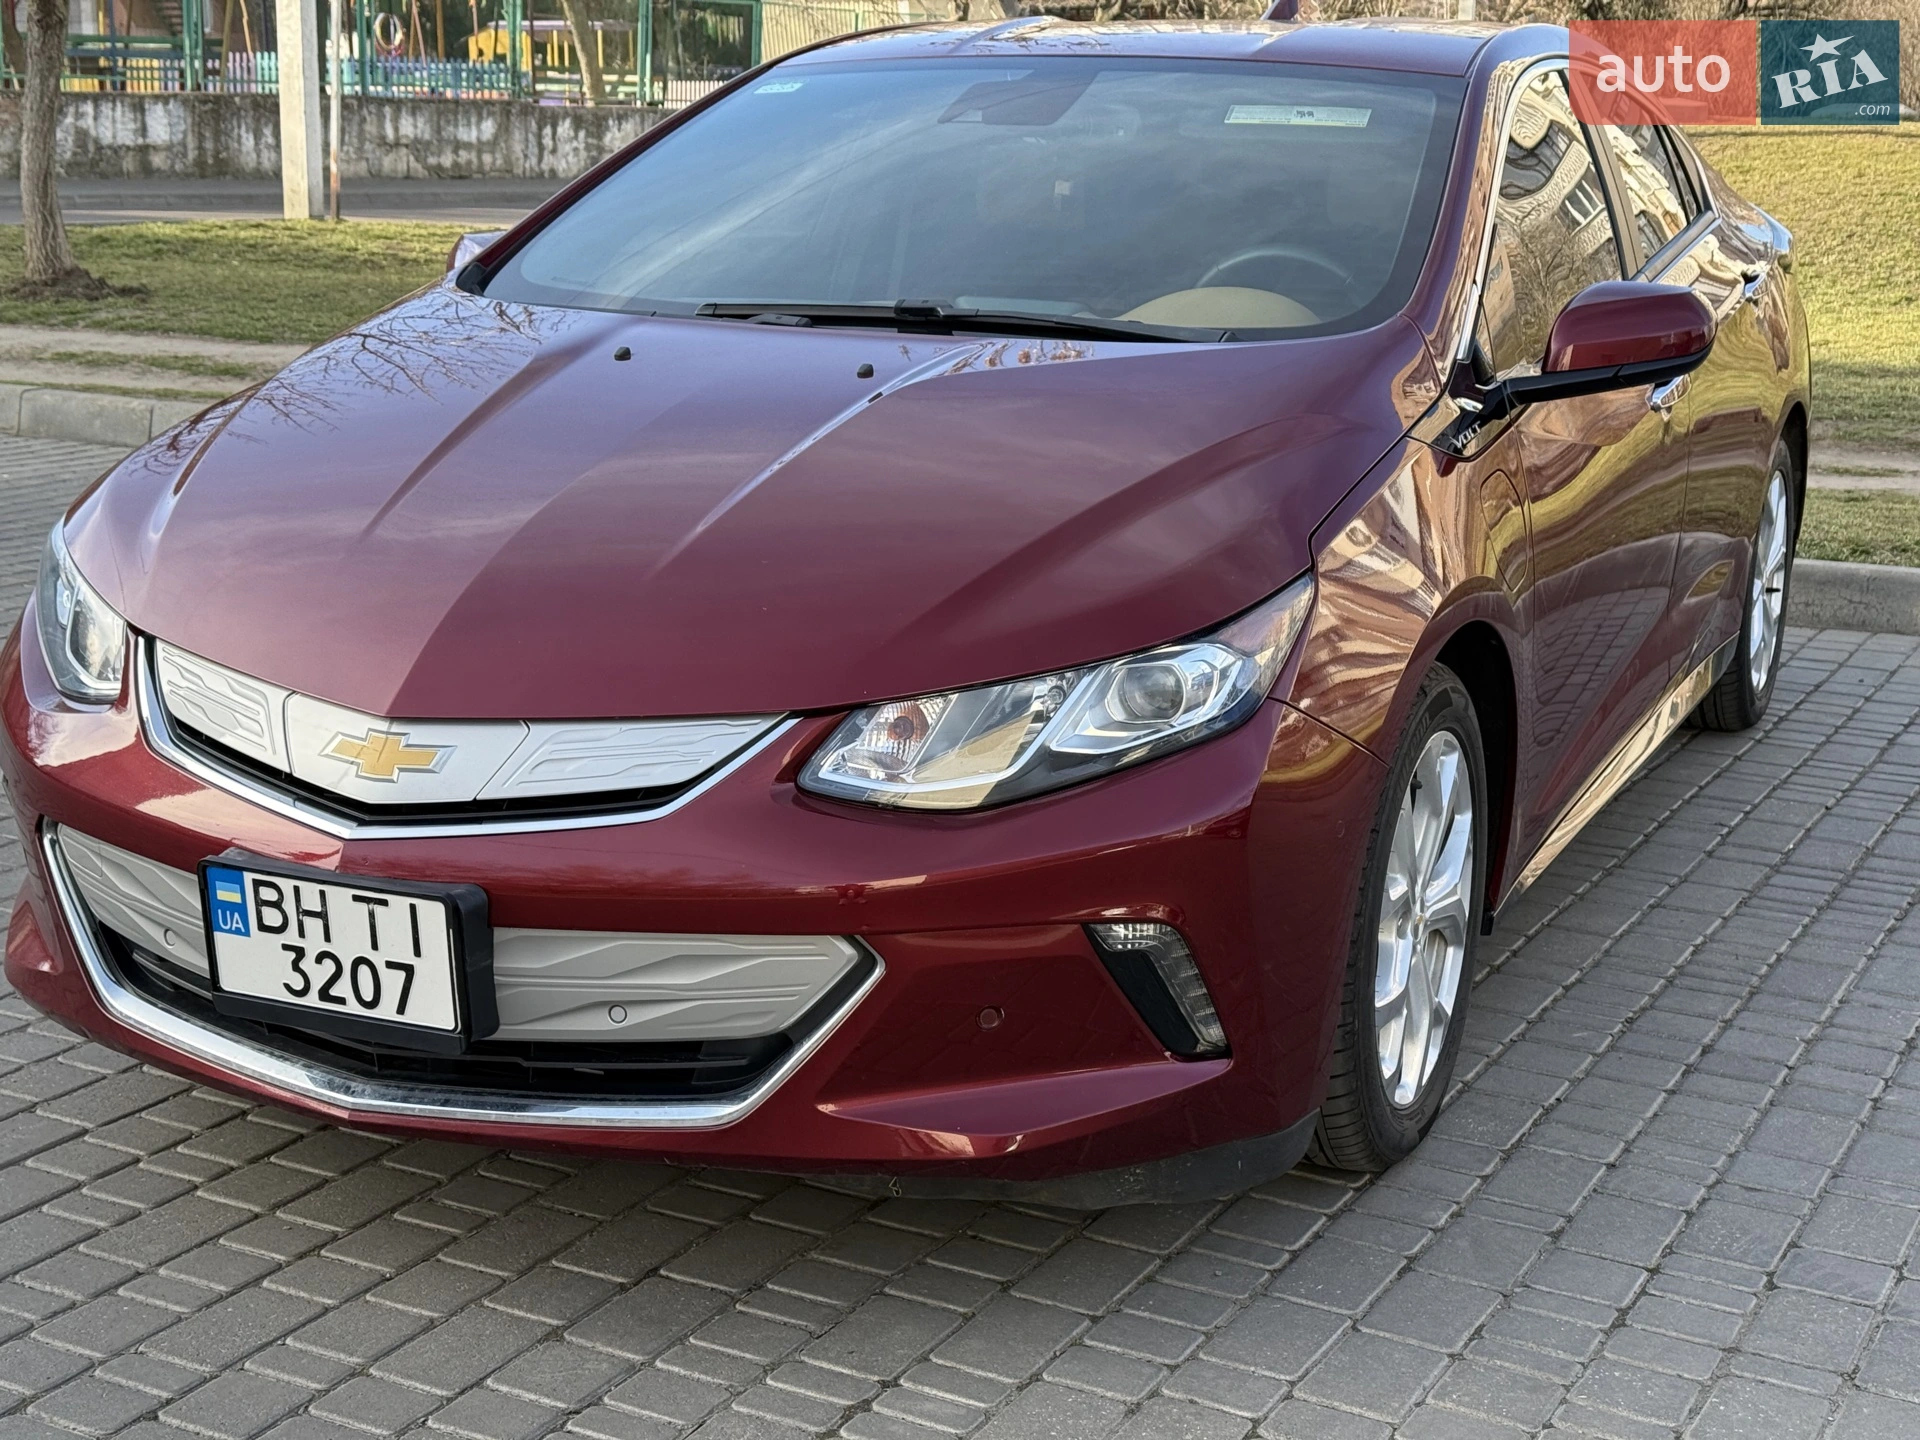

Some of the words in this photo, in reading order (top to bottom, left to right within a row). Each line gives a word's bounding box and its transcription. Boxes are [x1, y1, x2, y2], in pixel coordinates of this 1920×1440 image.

[1449, 421, 1481, 449] VOLT
[217, 908, 246, 934] UA
[252, 877, 332, 944] BH
[352, 894, 422, 958] TI
[281, 942, 415, 1016] 3207
